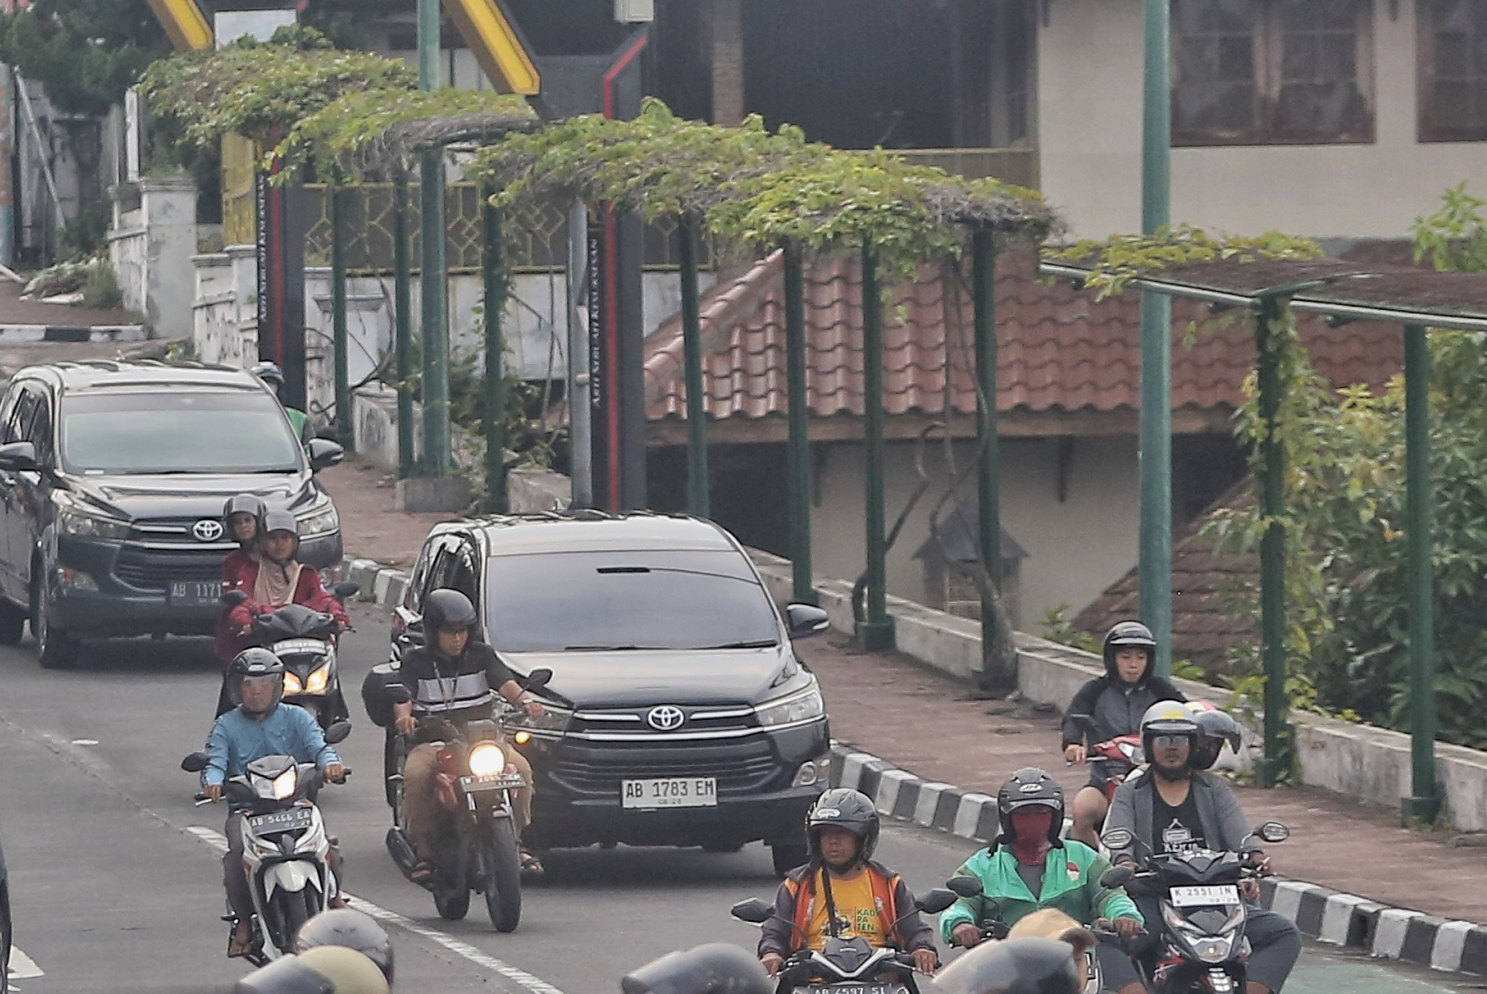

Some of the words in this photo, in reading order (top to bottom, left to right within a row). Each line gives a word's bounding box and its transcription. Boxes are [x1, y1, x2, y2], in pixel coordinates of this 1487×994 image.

[172, 583, 186, 597] AB
[196, 583, 221, 597] 1171
[626, 782, 643, 798] AB
[652, 781, 688, 797] 1783
[251, 817, 264, 826] AB
[1174, 888, 1182, 896] K
[1186, 887, 1213, 897] 2551
[857, 923, 874, 931] TEN
